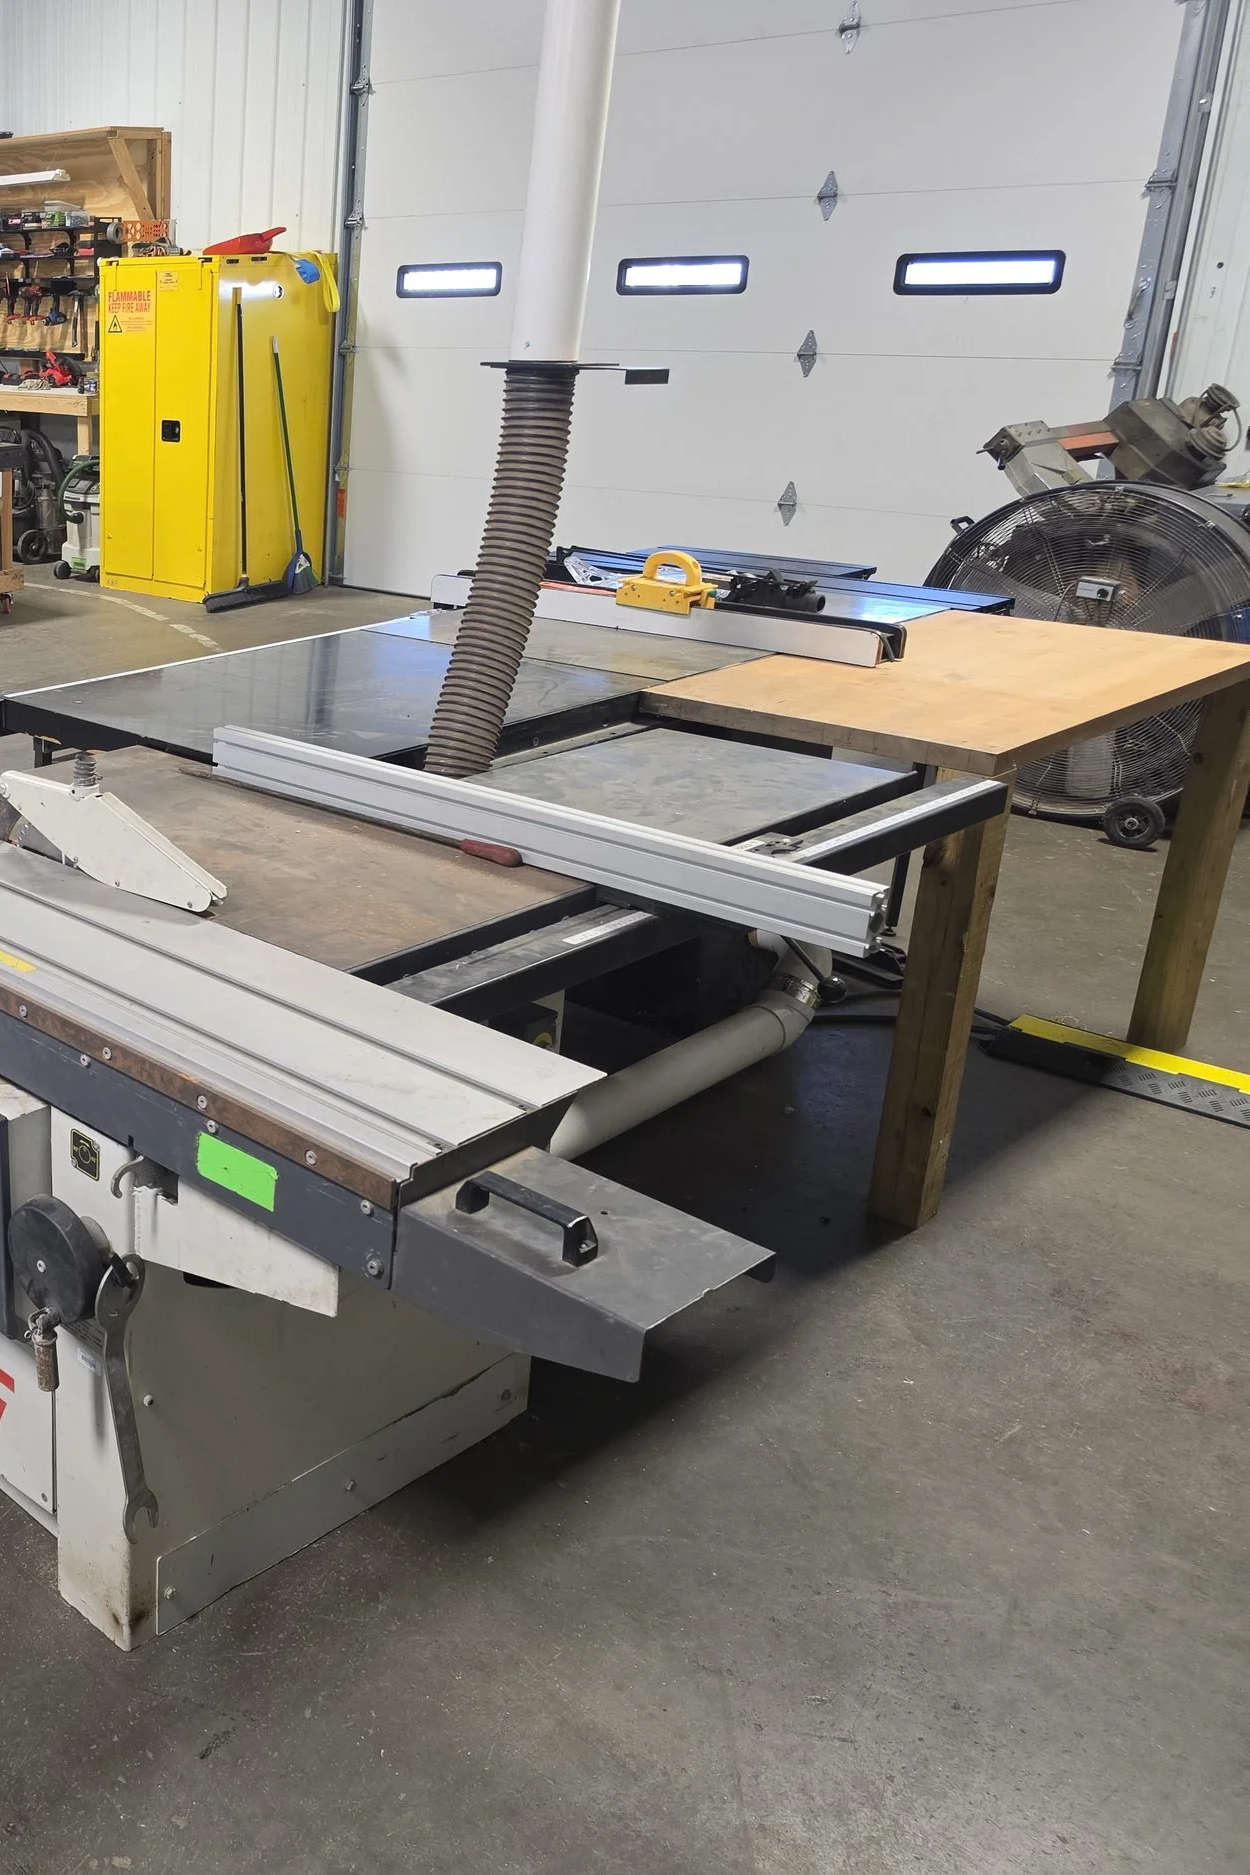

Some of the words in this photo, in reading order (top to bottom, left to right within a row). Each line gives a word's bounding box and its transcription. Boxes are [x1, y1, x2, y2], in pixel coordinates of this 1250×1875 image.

[108, 291, 151, 302] FLAMMABLE
[108, 303, 121, 313] KEEP
[122, 303, 134, 313] FIRE
[135, 302, 151, 312] AWAY
